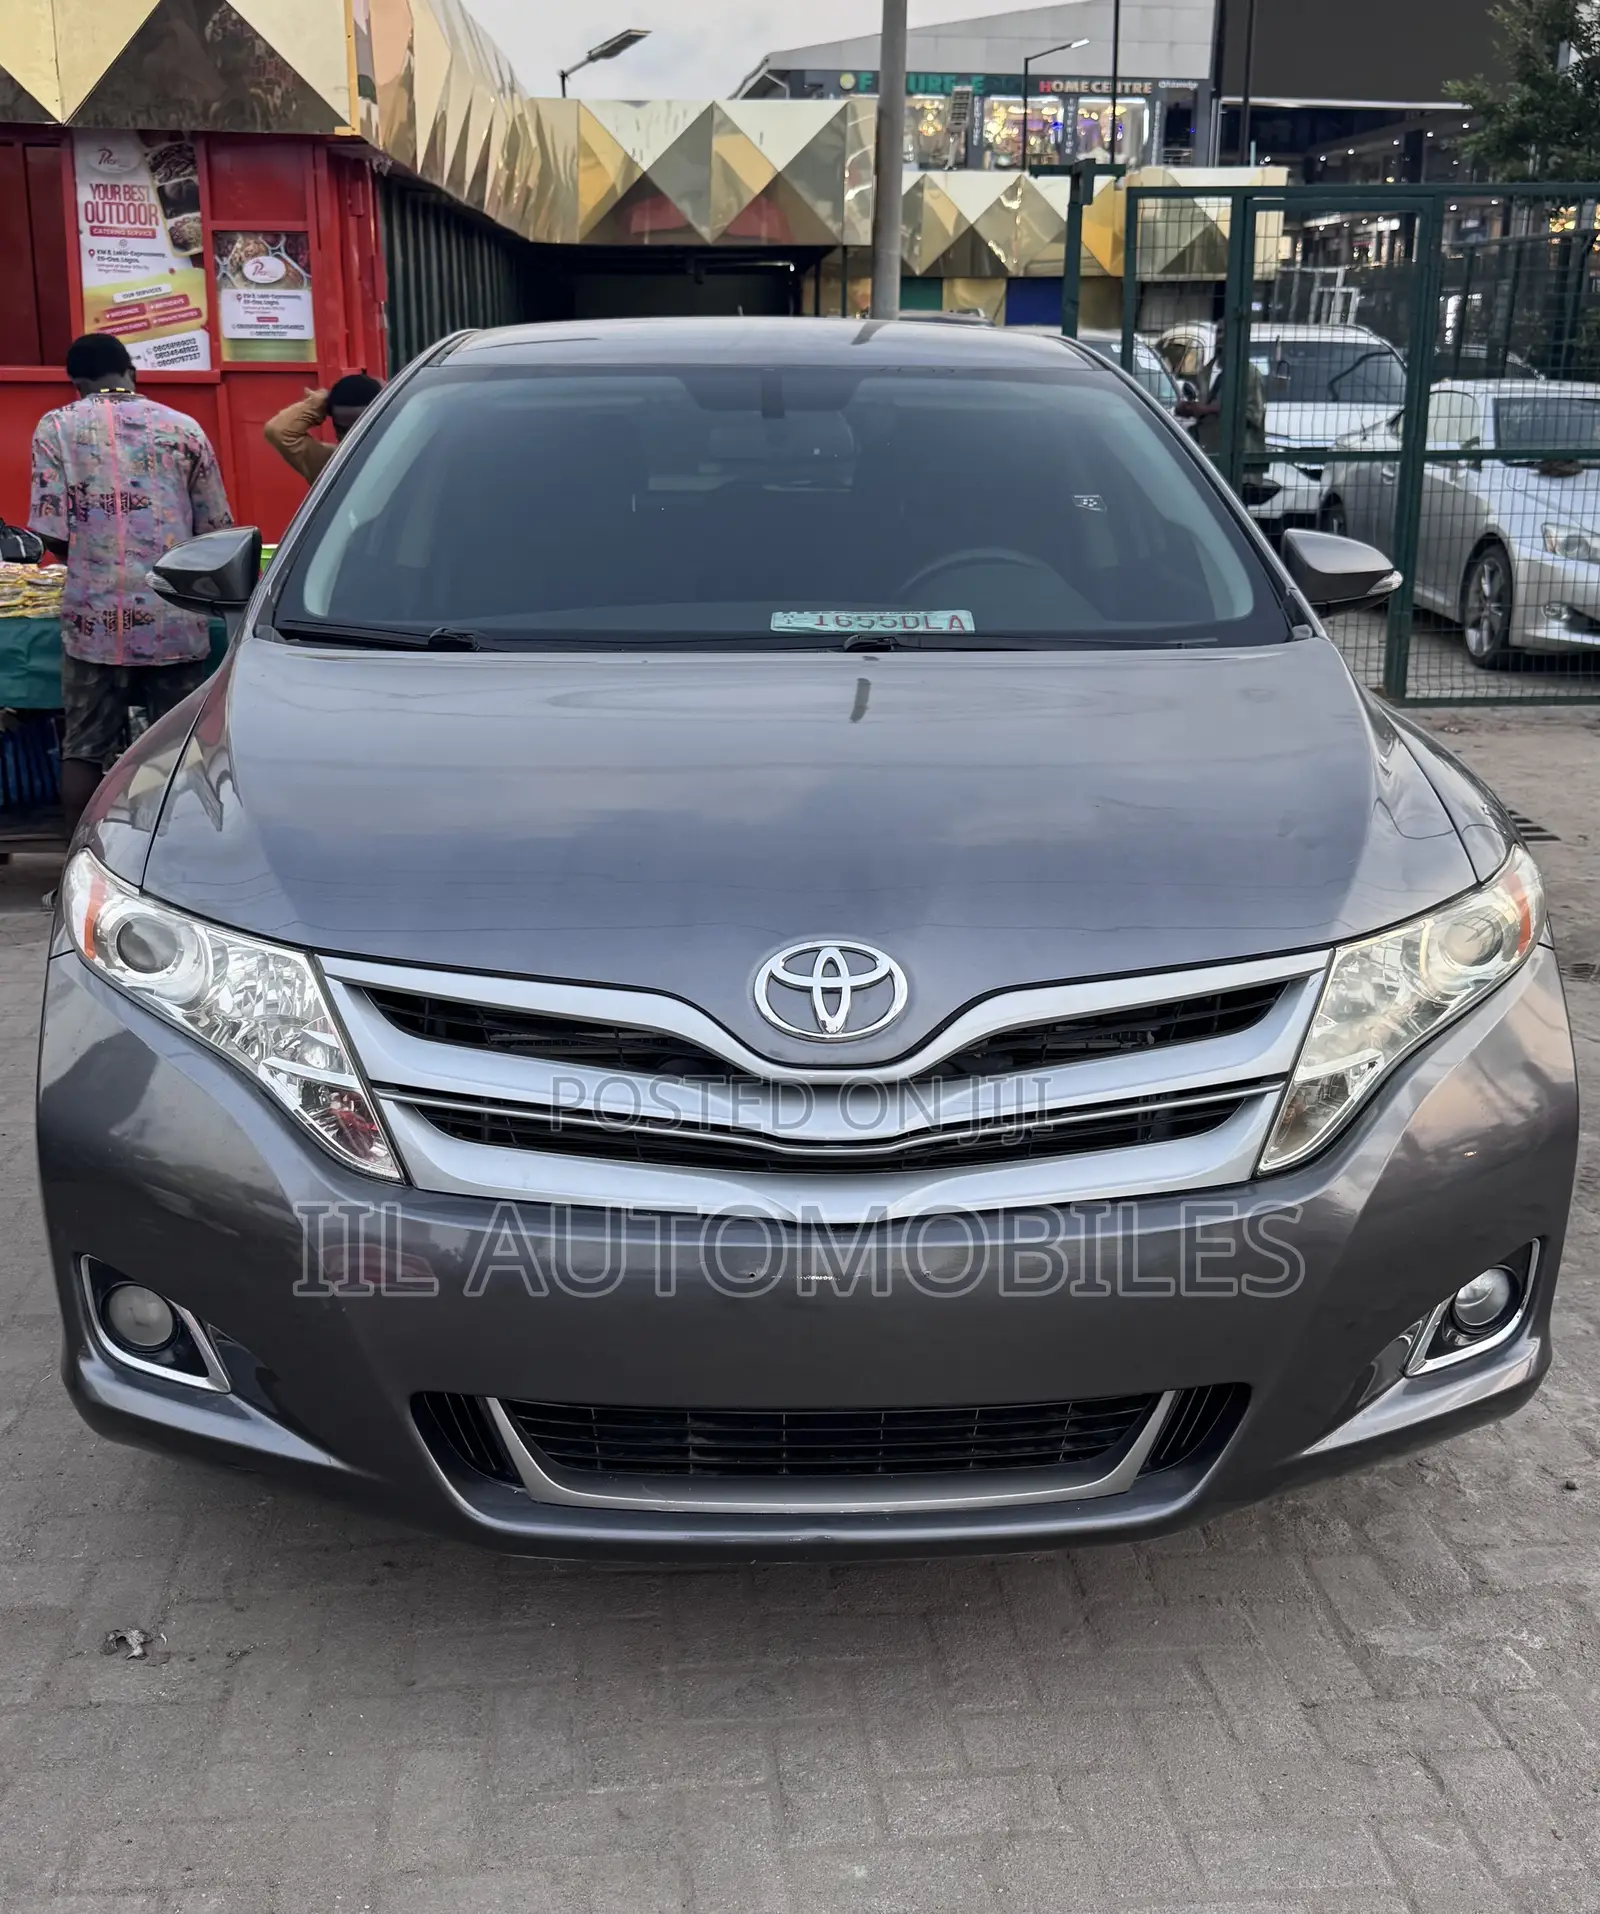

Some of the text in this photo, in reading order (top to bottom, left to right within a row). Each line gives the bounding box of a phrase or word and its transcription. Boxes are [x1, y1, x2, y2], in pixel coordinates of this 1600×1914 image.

[1039, 80, 1089, 94] HOME
[90, 183, 151, 202] YOUR BEST
[84, 201, 159, 226] OUTDOOR
[92, 227, 154, 238] CATERING SERVICE
